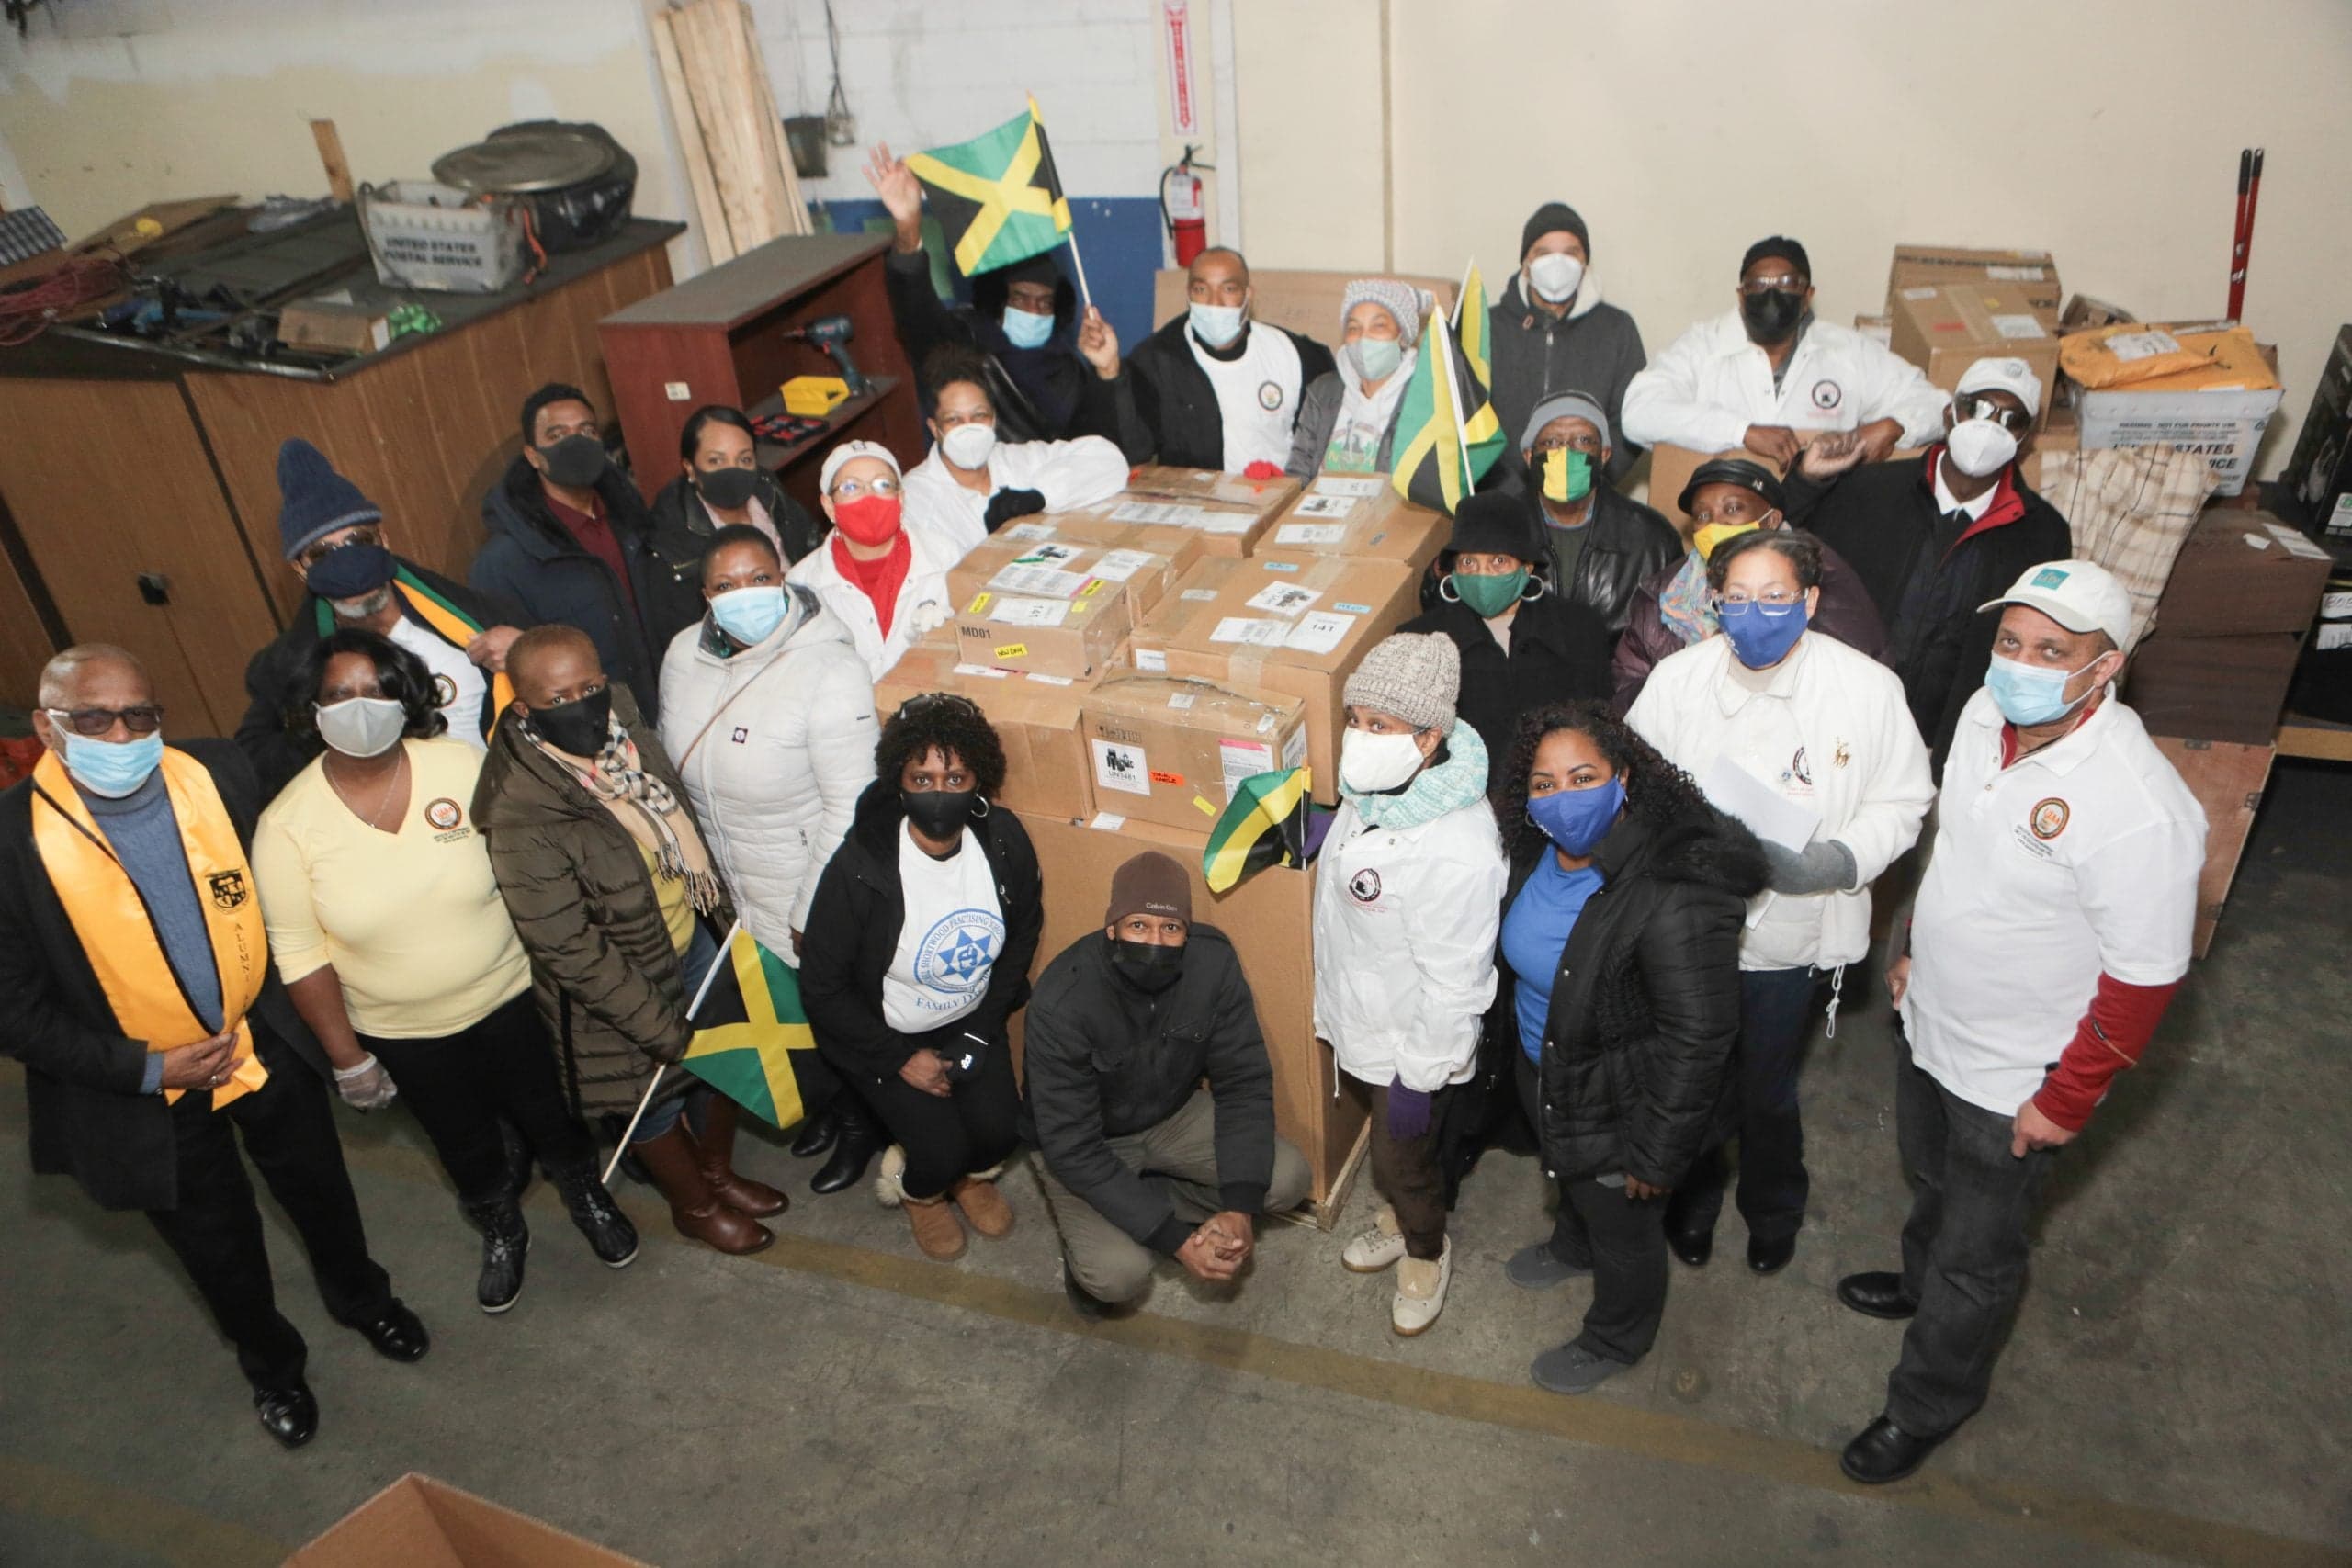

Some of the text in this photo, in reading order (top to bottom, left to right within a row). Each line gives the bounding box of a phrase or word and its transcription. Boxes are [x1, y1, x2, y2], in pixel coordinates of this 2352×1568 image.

[386, 238, 476, 253] UNITED STATES
[384, 251, 482, 267] POSTAL SERVICE
[2174, 444, 2233, 456] STATES
[961, 626, 991, 639] MD01
